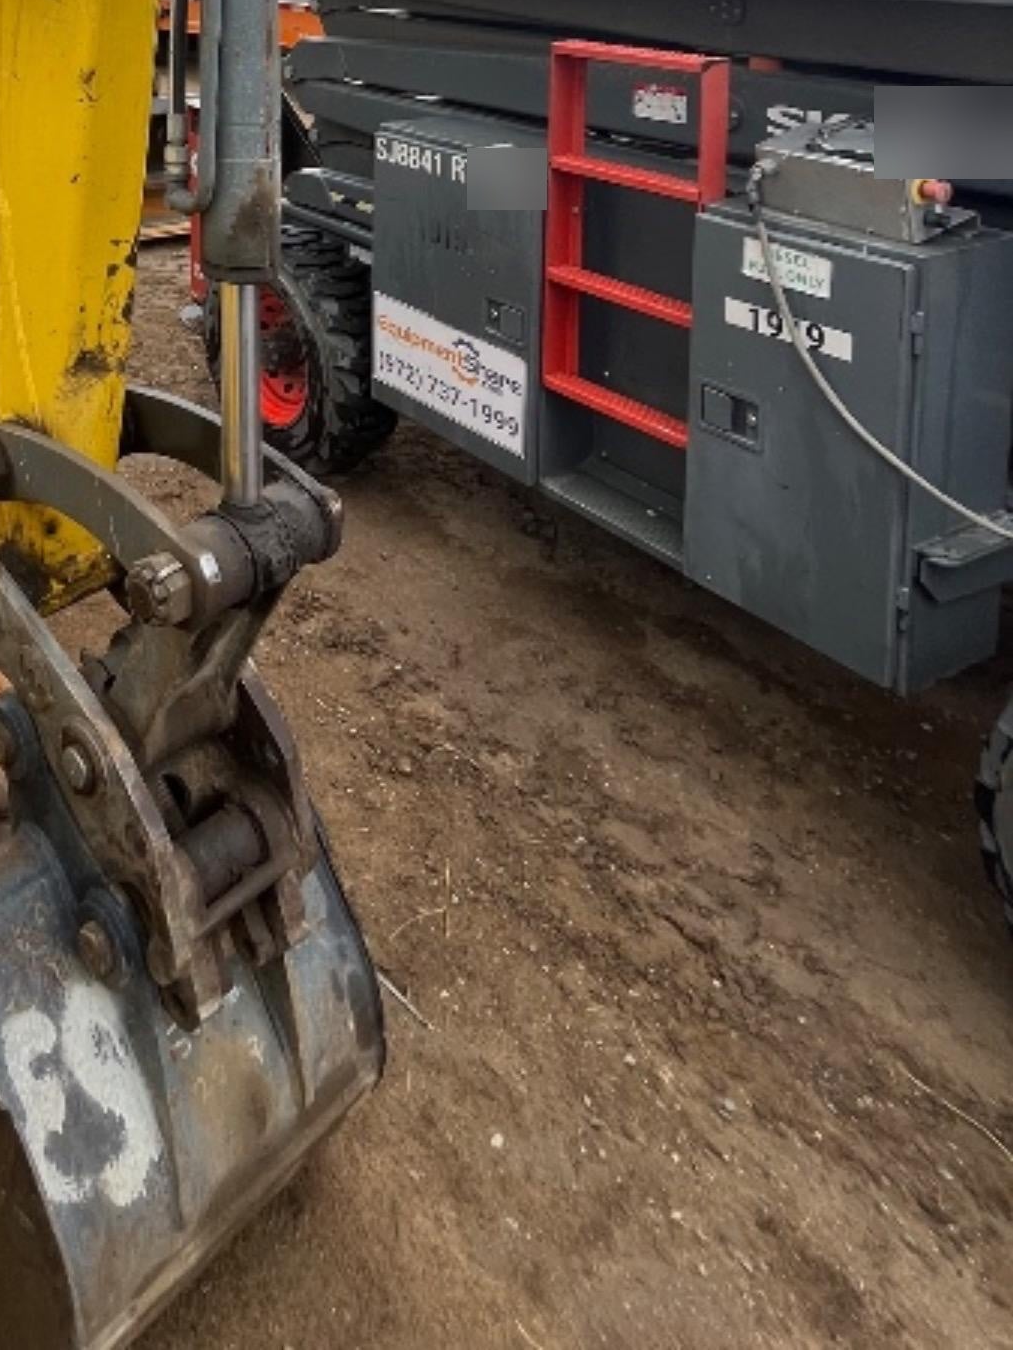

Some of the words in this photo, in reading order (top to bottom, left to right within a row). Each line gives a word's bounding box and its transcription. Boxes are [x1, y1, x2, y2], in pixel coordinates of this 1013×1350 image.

[375, 136, 442, 178] SJ8841
[451, 153, 468, 184] R
[748, 307, 825, 351] 199
